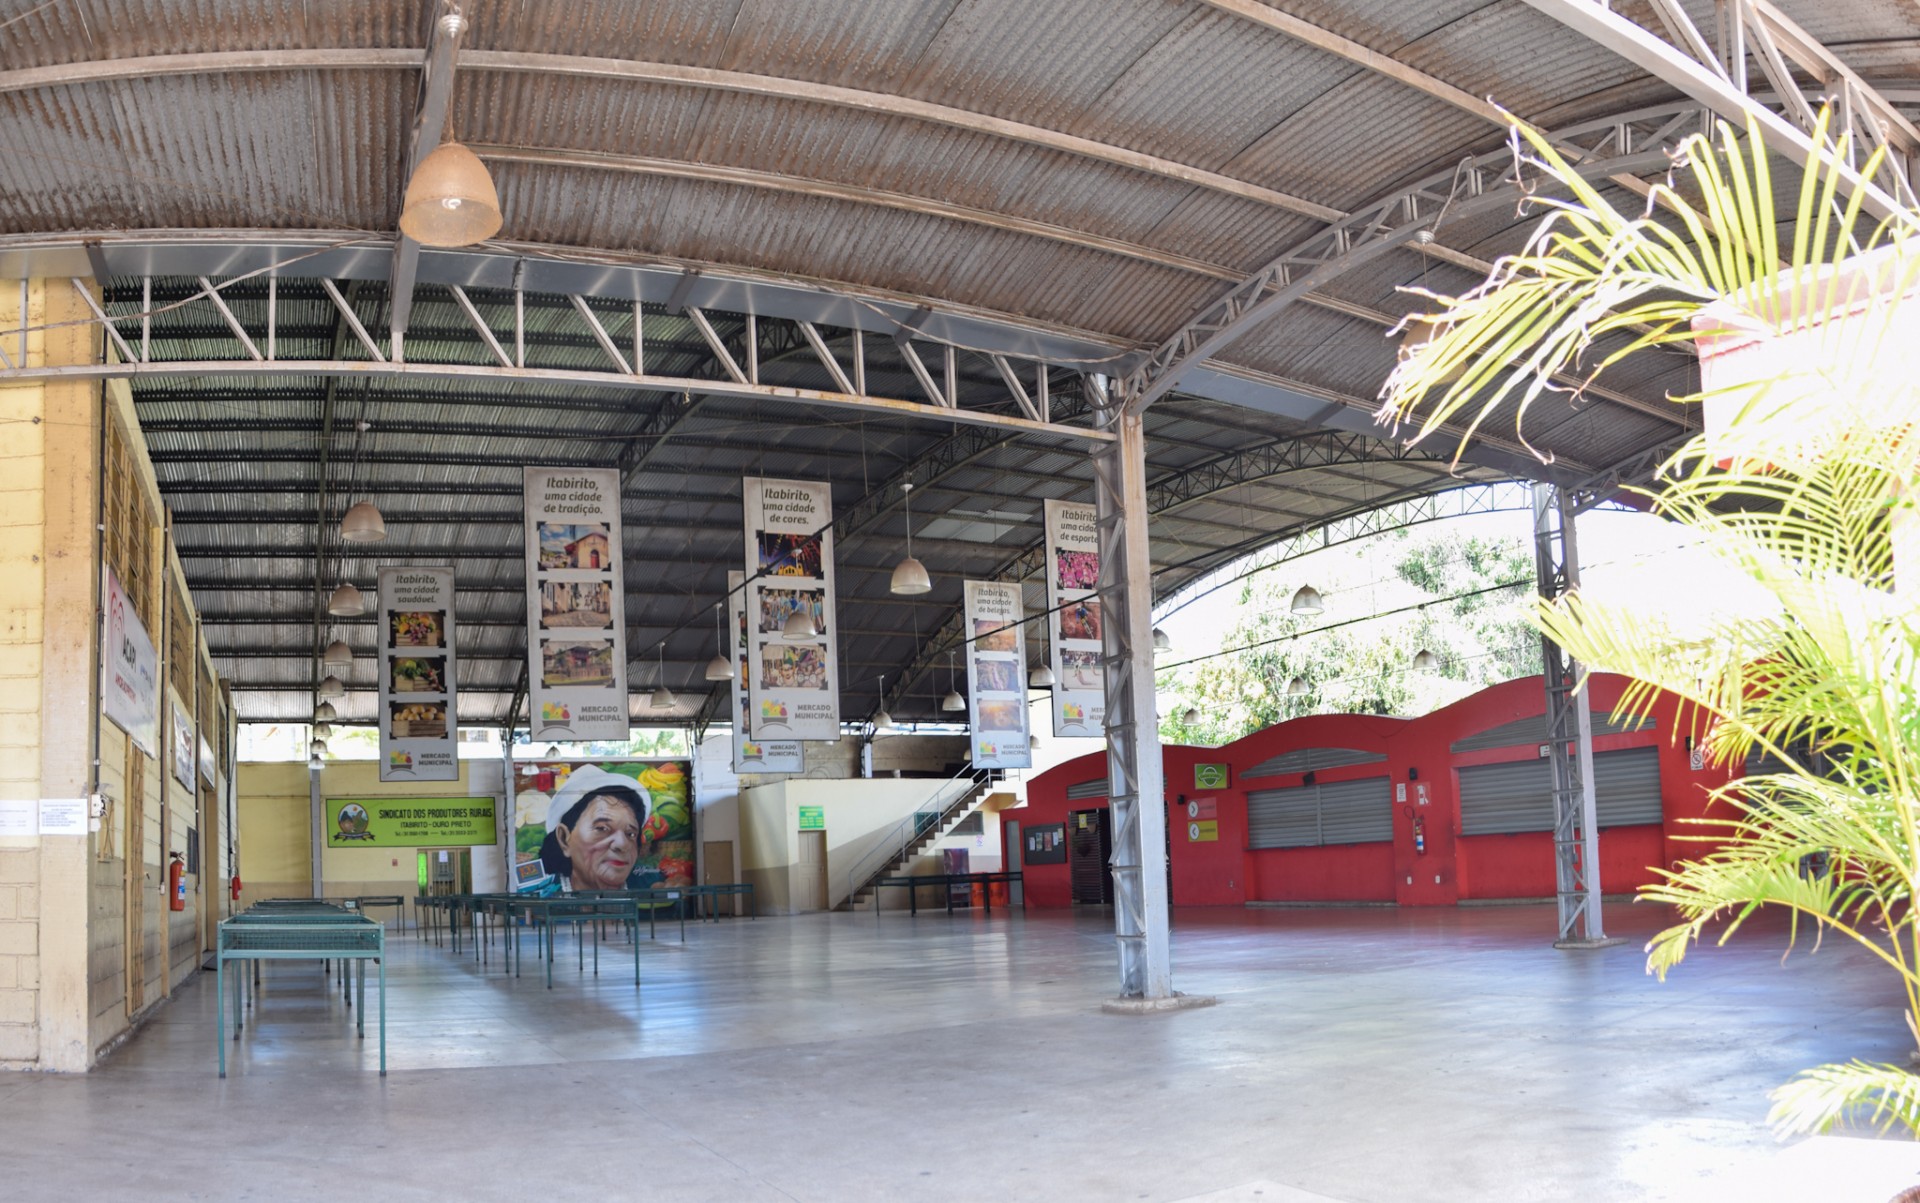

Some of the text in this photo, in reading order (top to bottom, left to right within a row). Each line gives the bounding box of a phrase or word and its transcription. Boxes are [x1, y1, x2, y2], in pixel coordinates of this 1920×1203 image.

[547, 477, 599, 491] Itabirito,
[544, 491, 602, 502] uma cidade
[765, 488, 812, 503] Itabirito,
[544, 504, 603, 516] de tradição.
[763, 503, 816, 513] uma cidade
[769, 514, 809, 525] de cores.
[1062, 509, 1097, 522] Itabirito
[1060, 523, 1097, 533] uma cida
[395, 575, 438, 585] Itabirito,
[413, 586, 440, 594] cidade
[977, 588, 1010, 599] Itabirito,
[397, 595, 437, 603] saudável.
[991, 598, 1012, 606] cidade
[578, 714, 622, 722] MUNICIPAL
[379, 808, 492, 819] SINDICATO DOS PRODUTORES RURAIS
